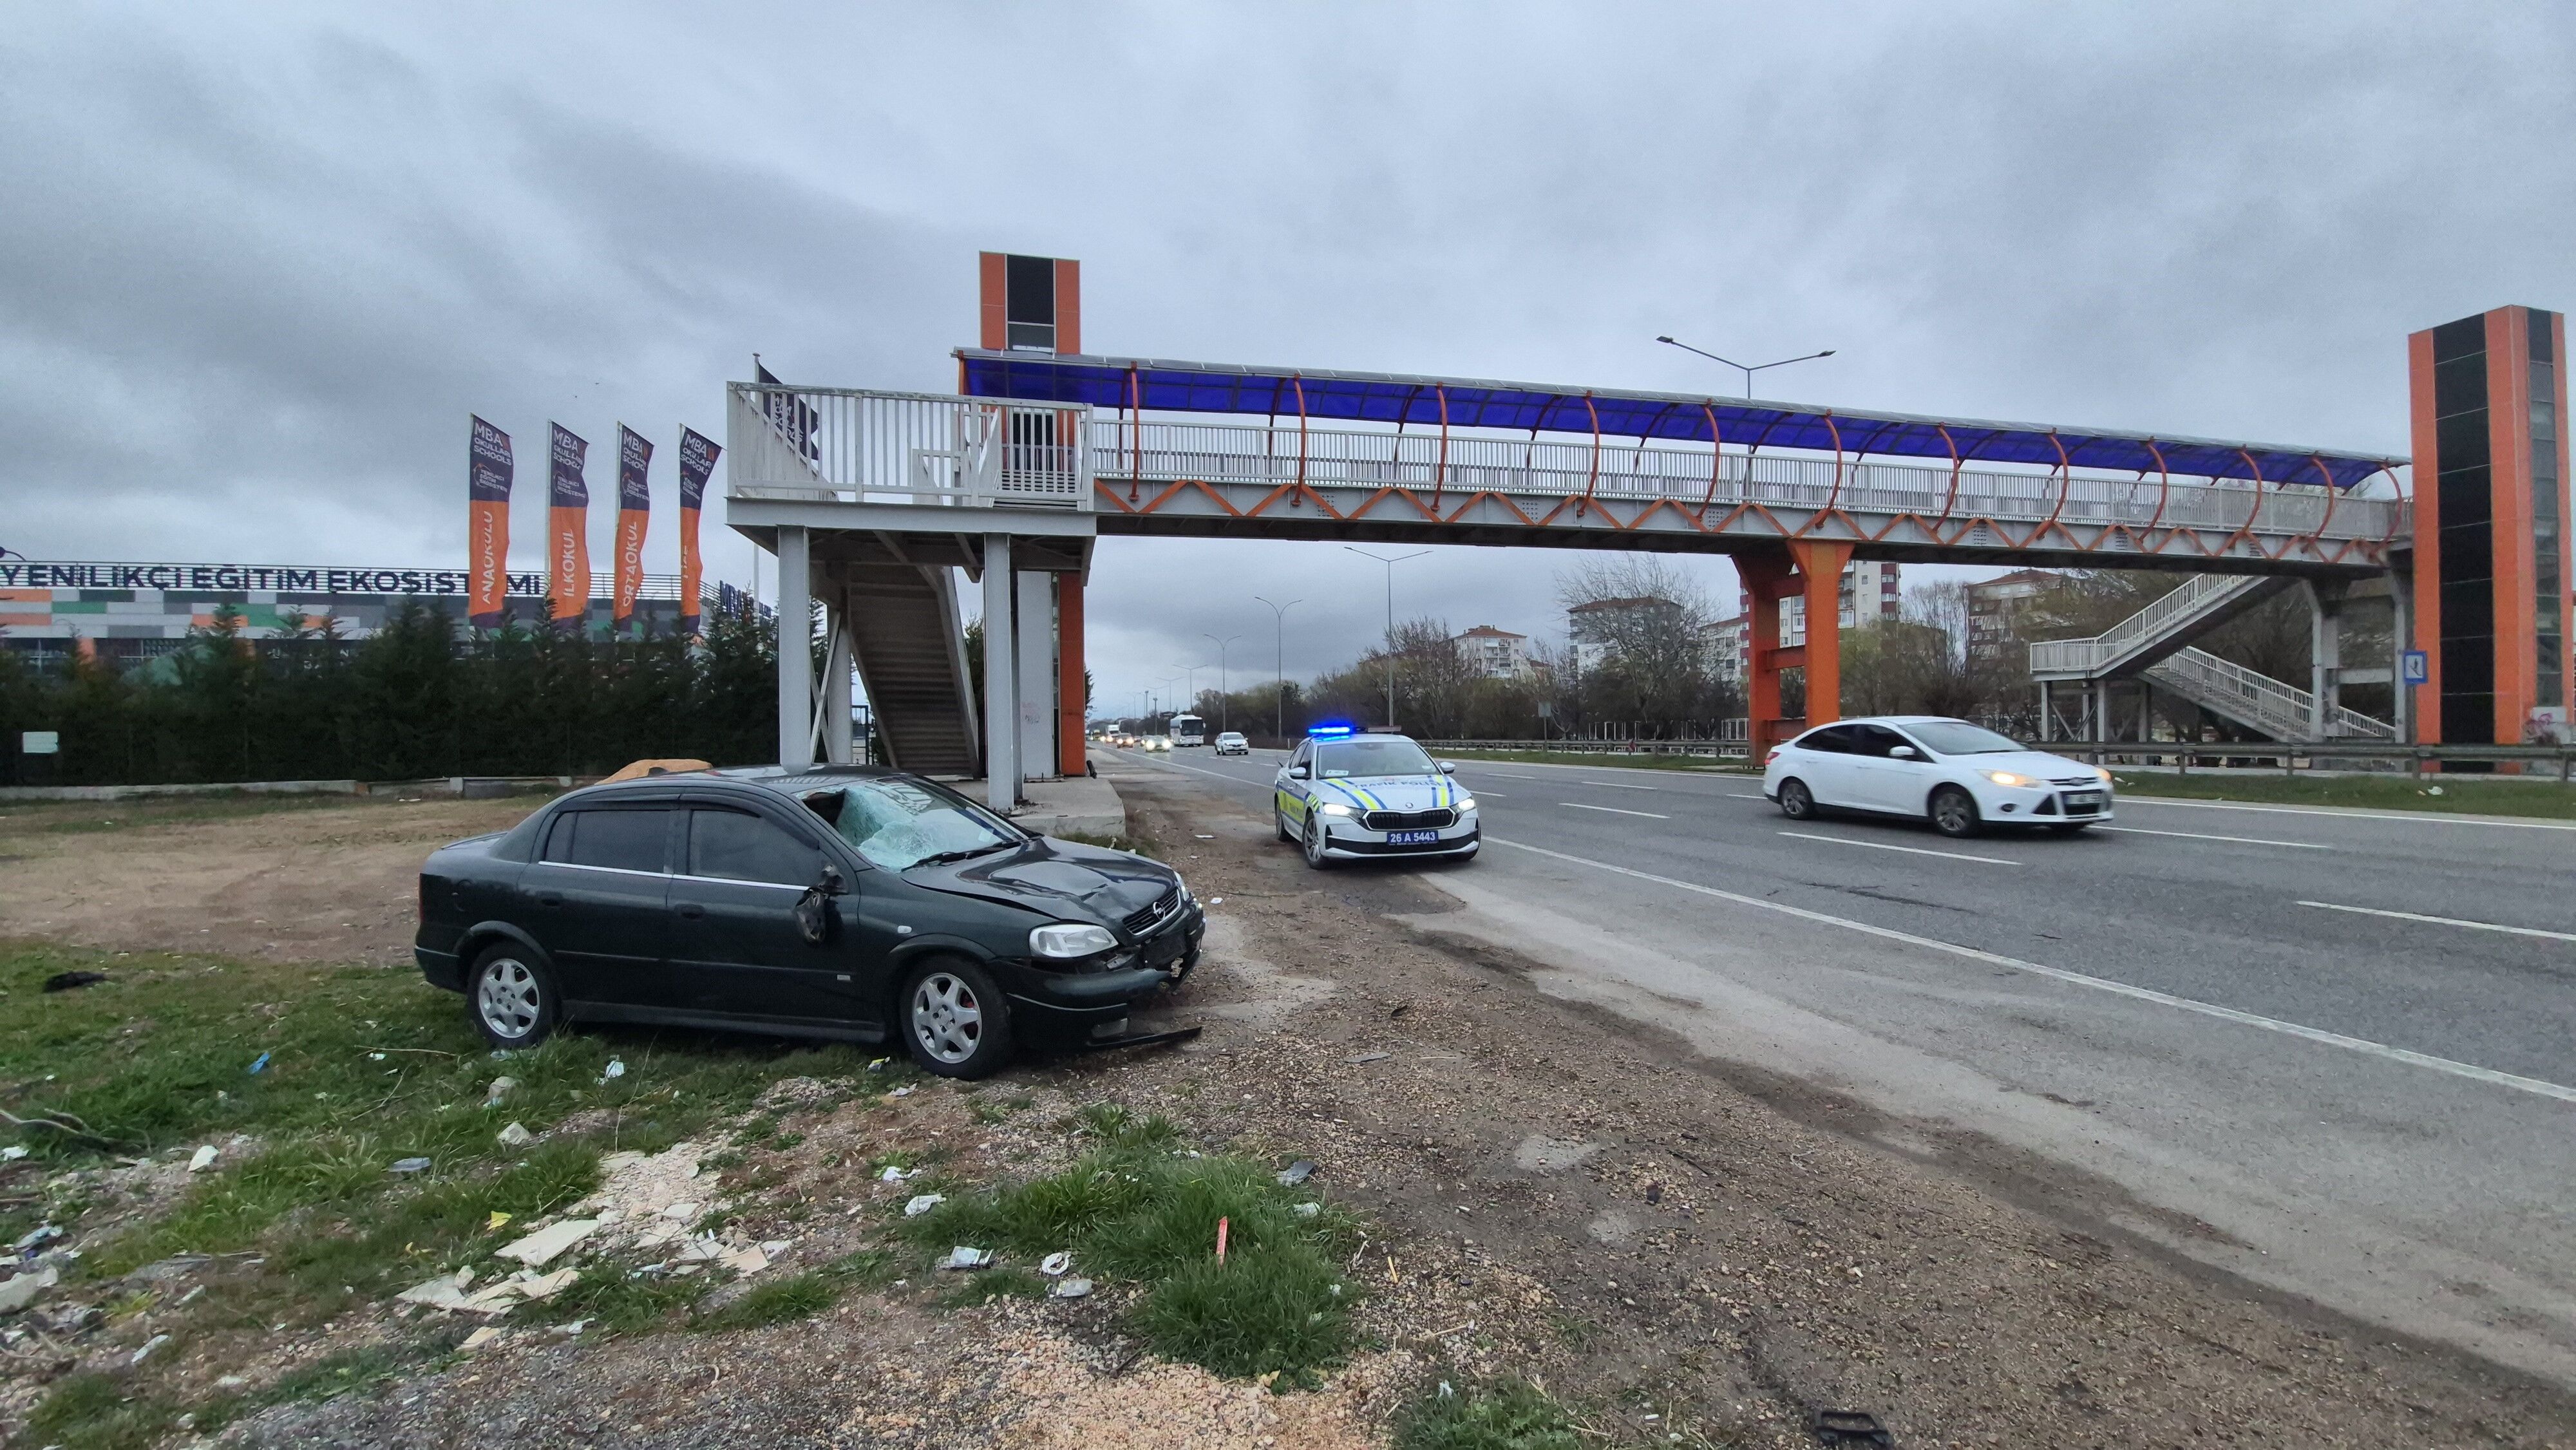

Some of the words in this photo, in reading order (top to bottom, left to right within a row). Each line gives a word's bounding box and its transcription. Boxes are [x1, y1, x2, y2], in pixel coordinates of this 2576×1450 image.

[474, 422, 504, 447] MBA
[554, 429, 578, 453] MBA
[684, 434, 707, 457] MBA
[473, 445, 512, 466] SCHOOLS
[680, 454, 709, 476] SCHOOLS
[482, 511, 495, 605] ANAOKULU
[623, 522, 638, 607] ORTAOKUL
[327, 570, 540, 595] EKOSİSTMİ
[1390, 833, 1402, 843] 26
[1404, 833, 1412, 842] A
[1414, 831, 1435, 842] 5443
